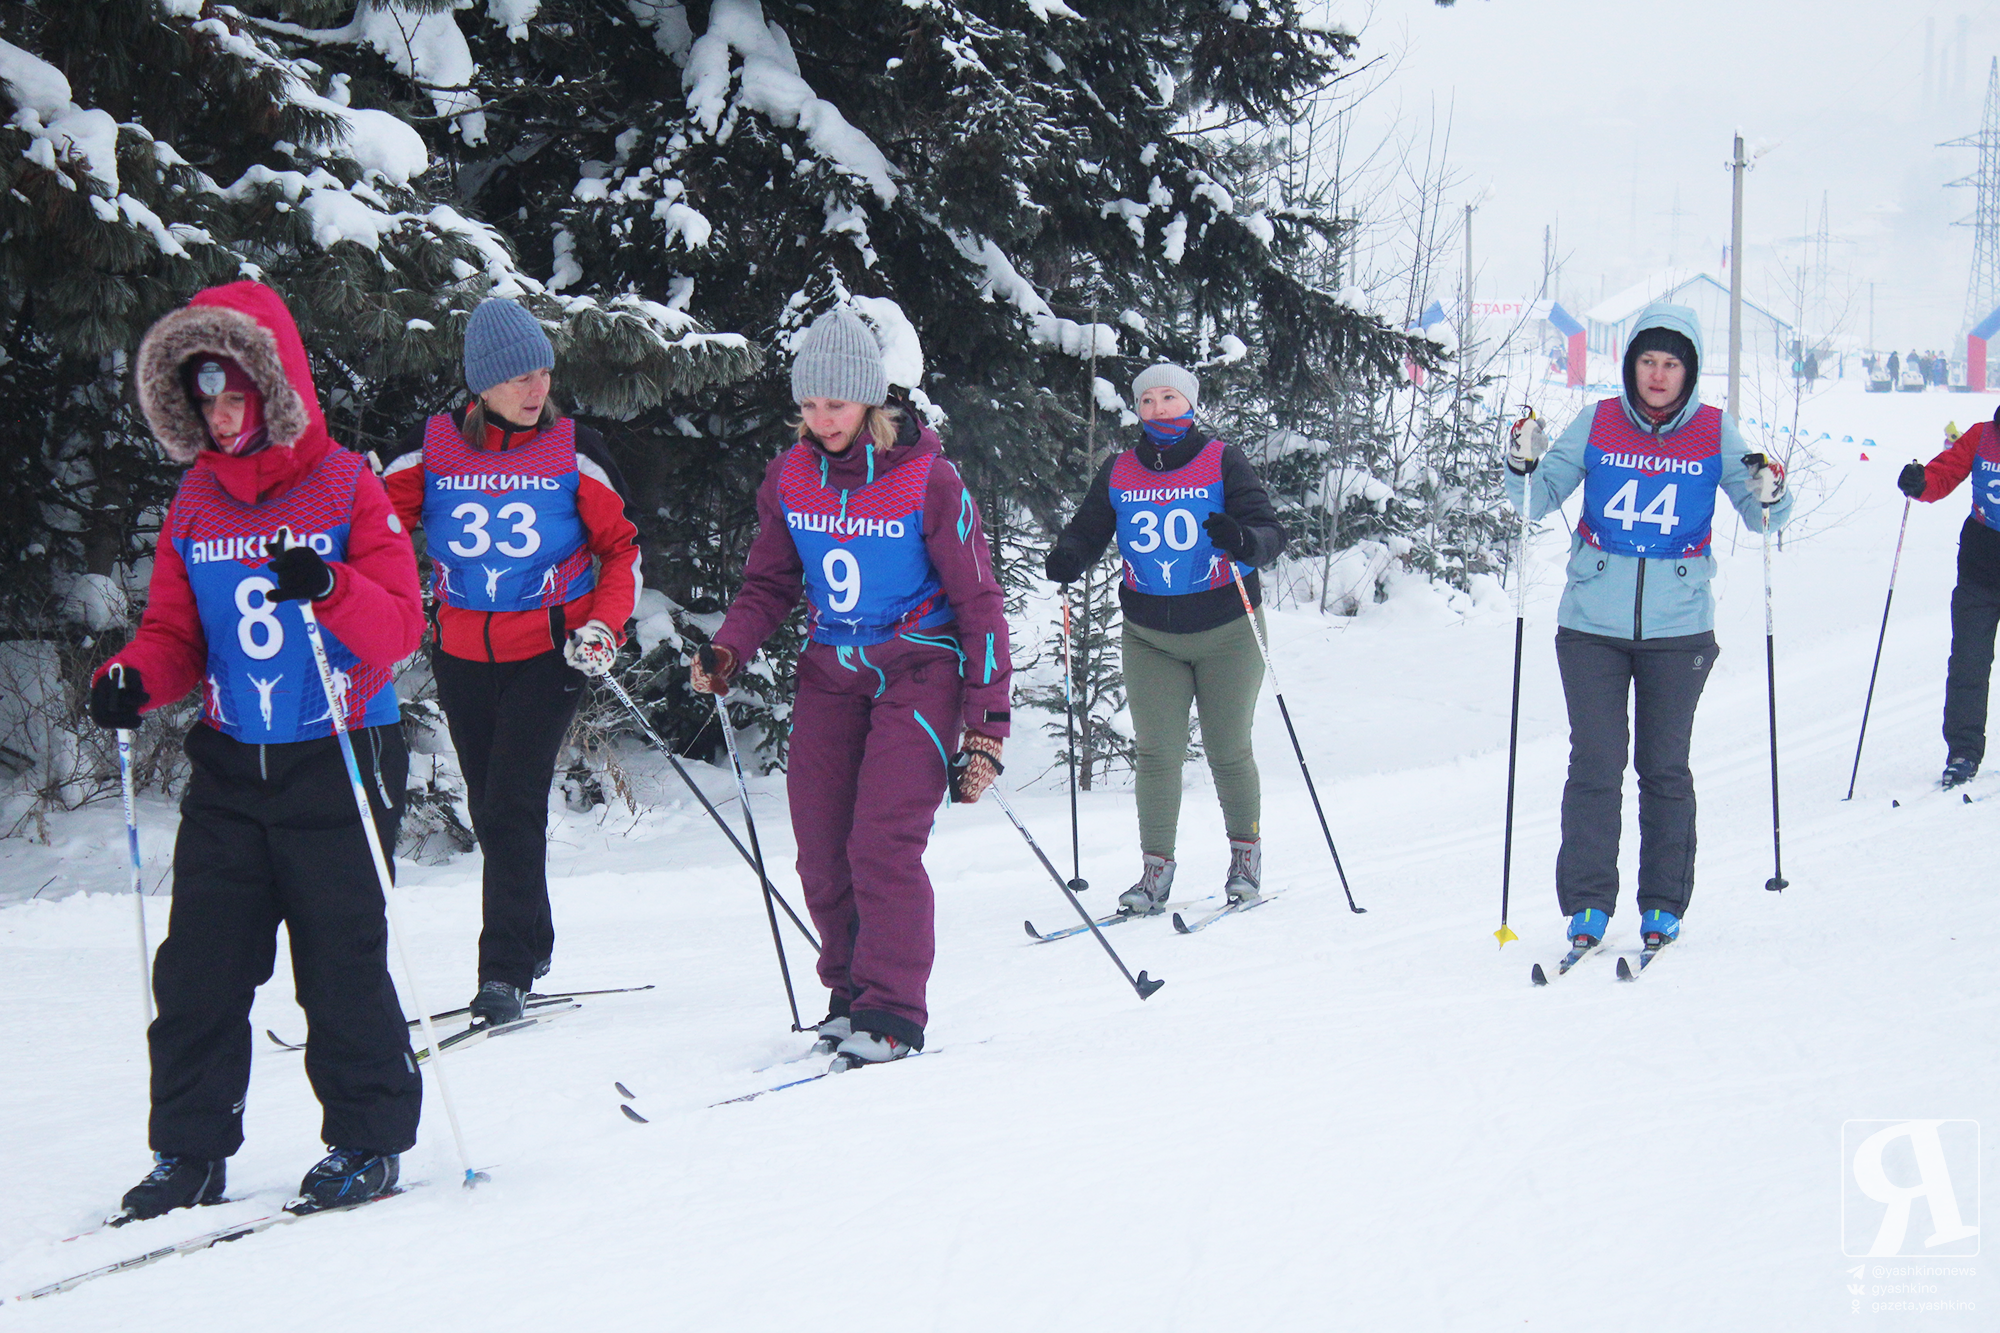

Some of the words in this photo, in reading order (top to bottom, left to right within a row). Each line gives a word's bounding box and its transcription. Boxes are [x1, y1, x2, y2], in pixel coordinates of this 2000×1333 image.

[1471, 303, 1522, 315] СТАРТ
[1600, 453, 1703, 475] ЯШКИНО
[436, 474, 560, 490] ЯШКИНО
[1120, 487, 1209, 502] ЯШКИНО
[1603, 479, 1680, 535] 44
[448, 502, 541, 558] 33
[787, 512, 905, 538] ЯШКИНО
[1129, 508, 1198, 553] 30
[822, 548, 861, 613] 9
[234, 576, 284, 660] 8
